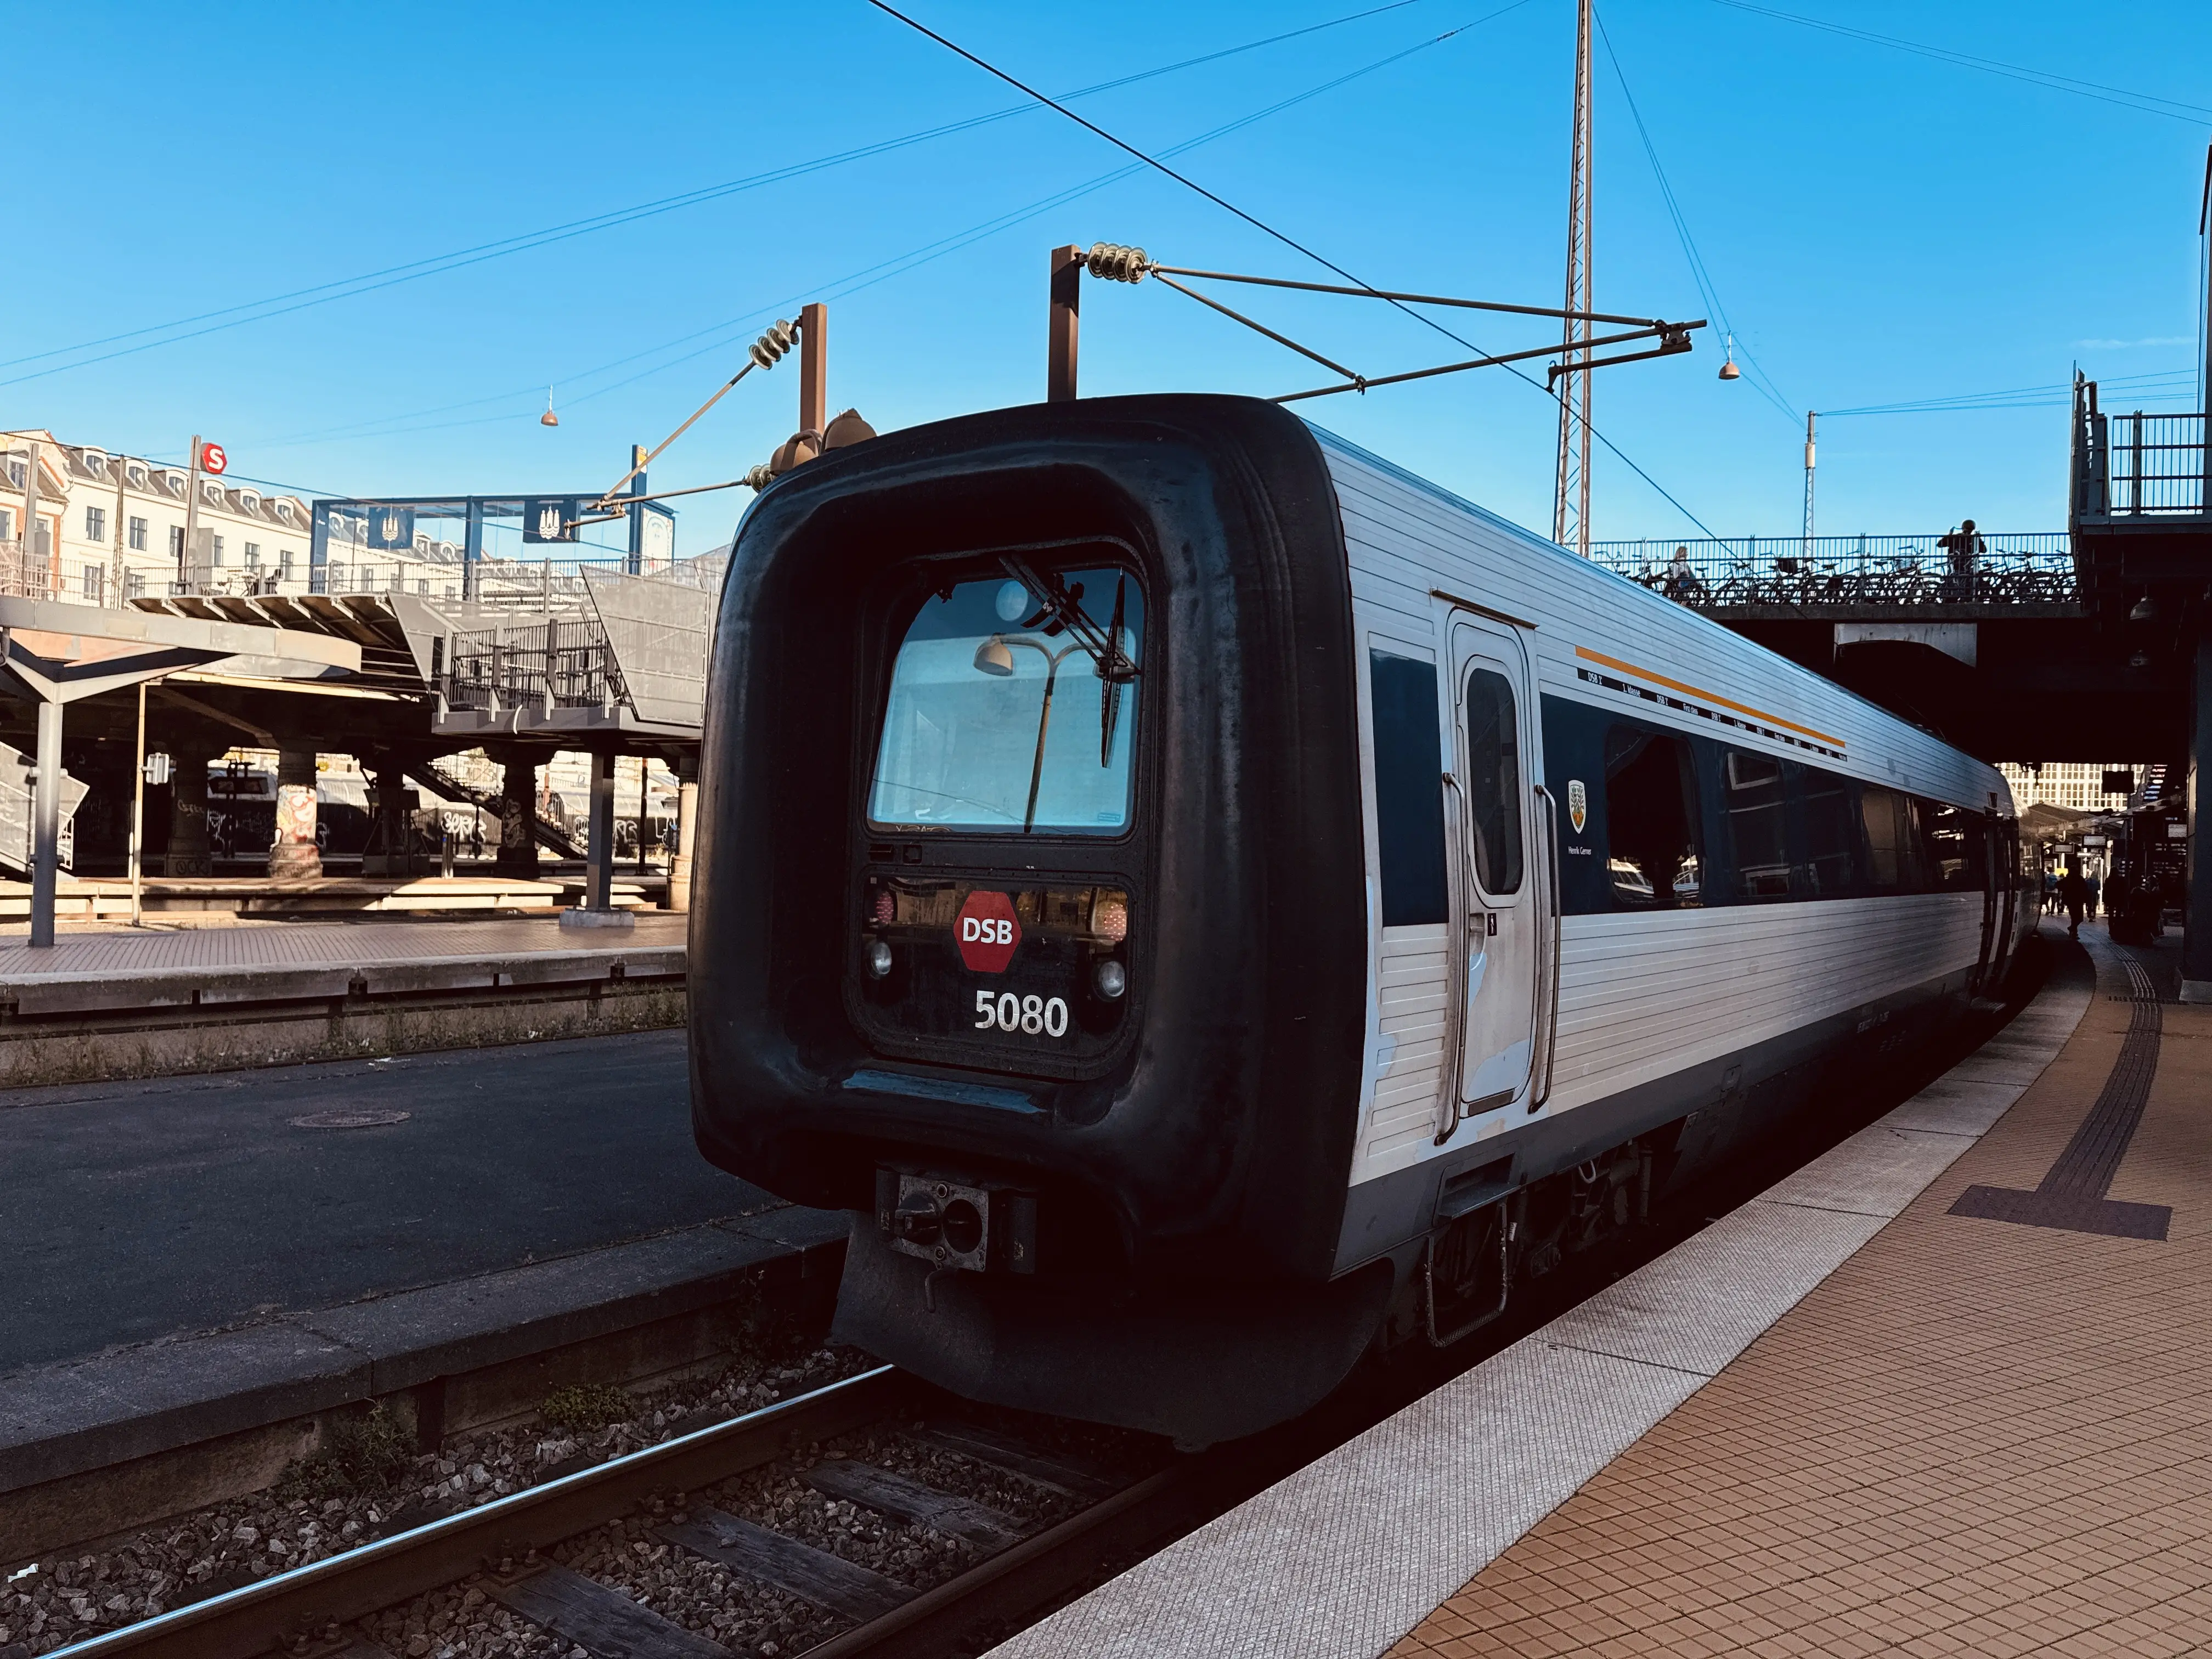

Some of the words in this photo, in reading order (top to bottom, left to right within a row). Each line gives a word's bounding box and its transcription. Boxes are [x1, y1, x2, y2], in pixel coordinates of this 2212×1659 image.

[209, 448, 223, 470] S
[1588, 672, 1598, 684] DSB
[1627, 685, 1641, 697] klasse
[1657, 695, 1665, 704] DSB
[963, 917, 1013, 945] DSB
[975, 990, 1068, 1037] 5080
